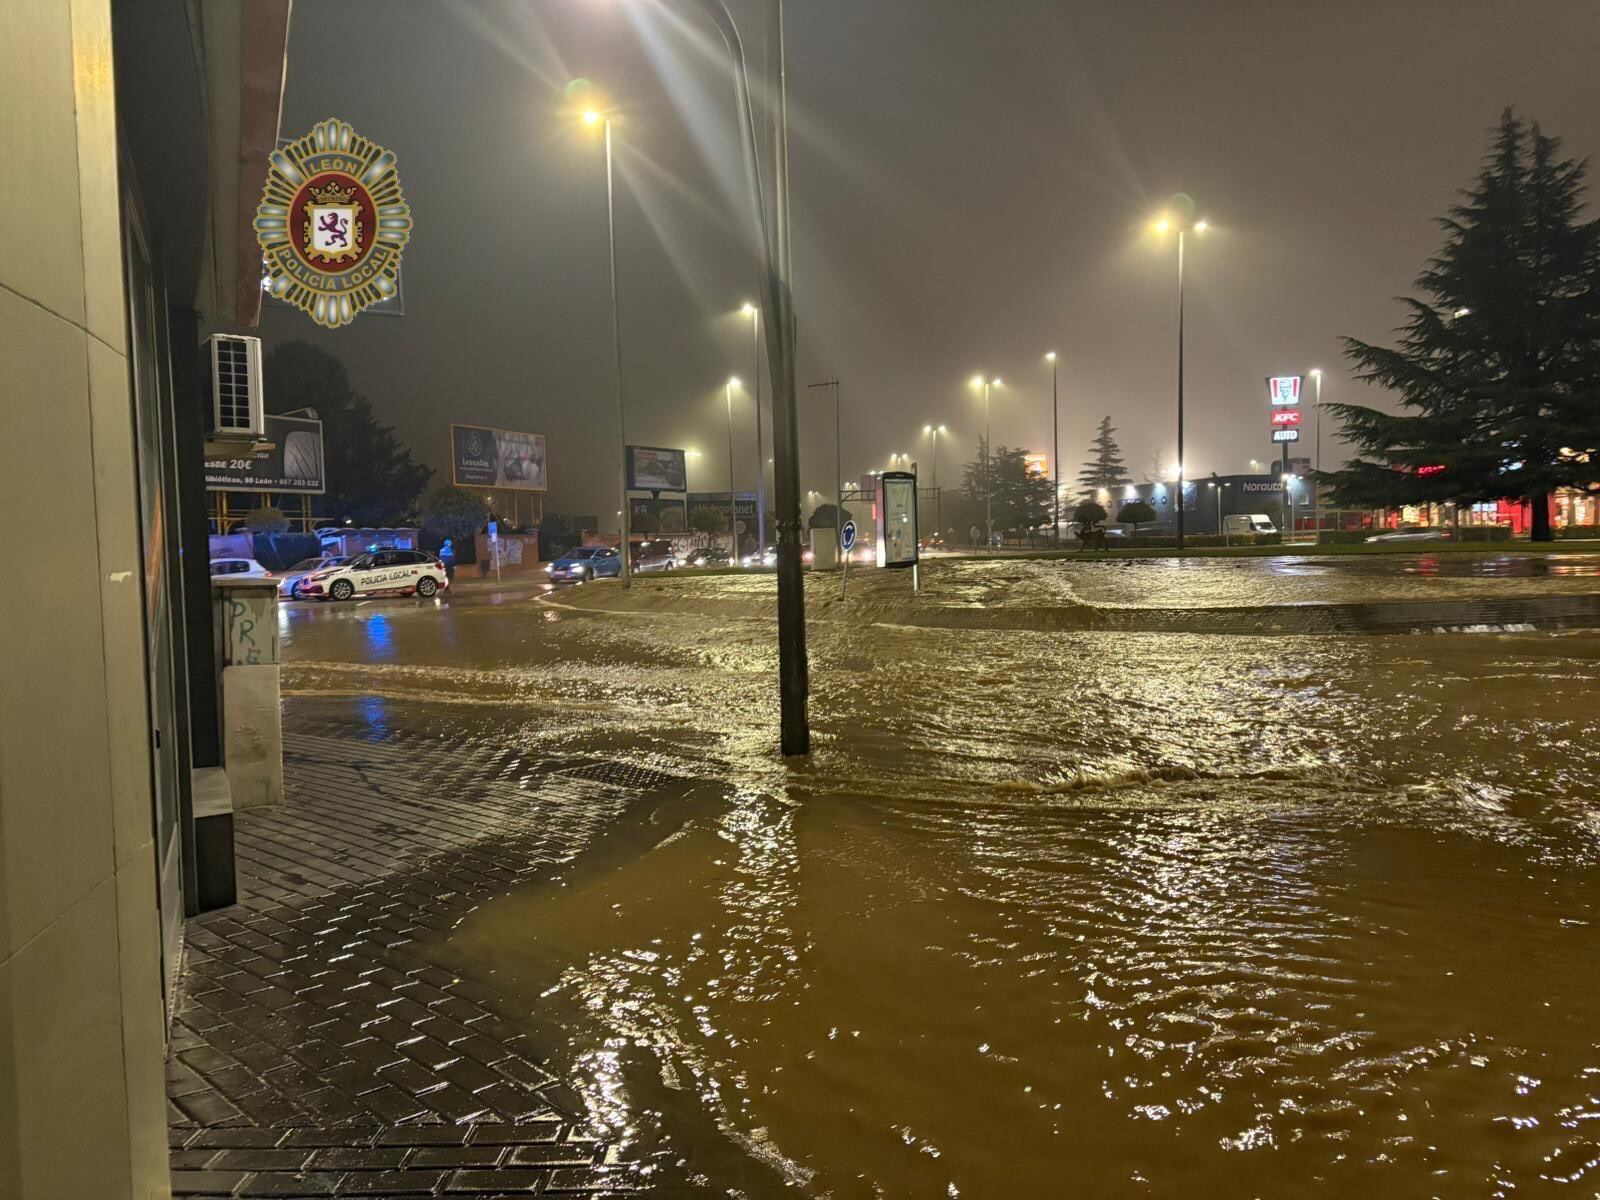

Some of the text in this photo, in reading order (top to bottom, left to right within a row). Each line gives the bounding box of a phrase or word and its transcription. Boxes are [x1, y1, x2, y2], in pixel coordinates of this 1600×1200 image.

[1274, 430, 1298, 441] AUTO
[204, 459, 252, 470] ESDE 20€
[1243, 481, 1283, 492] Norauto
[388, 570, 412, 582] LOCAL
